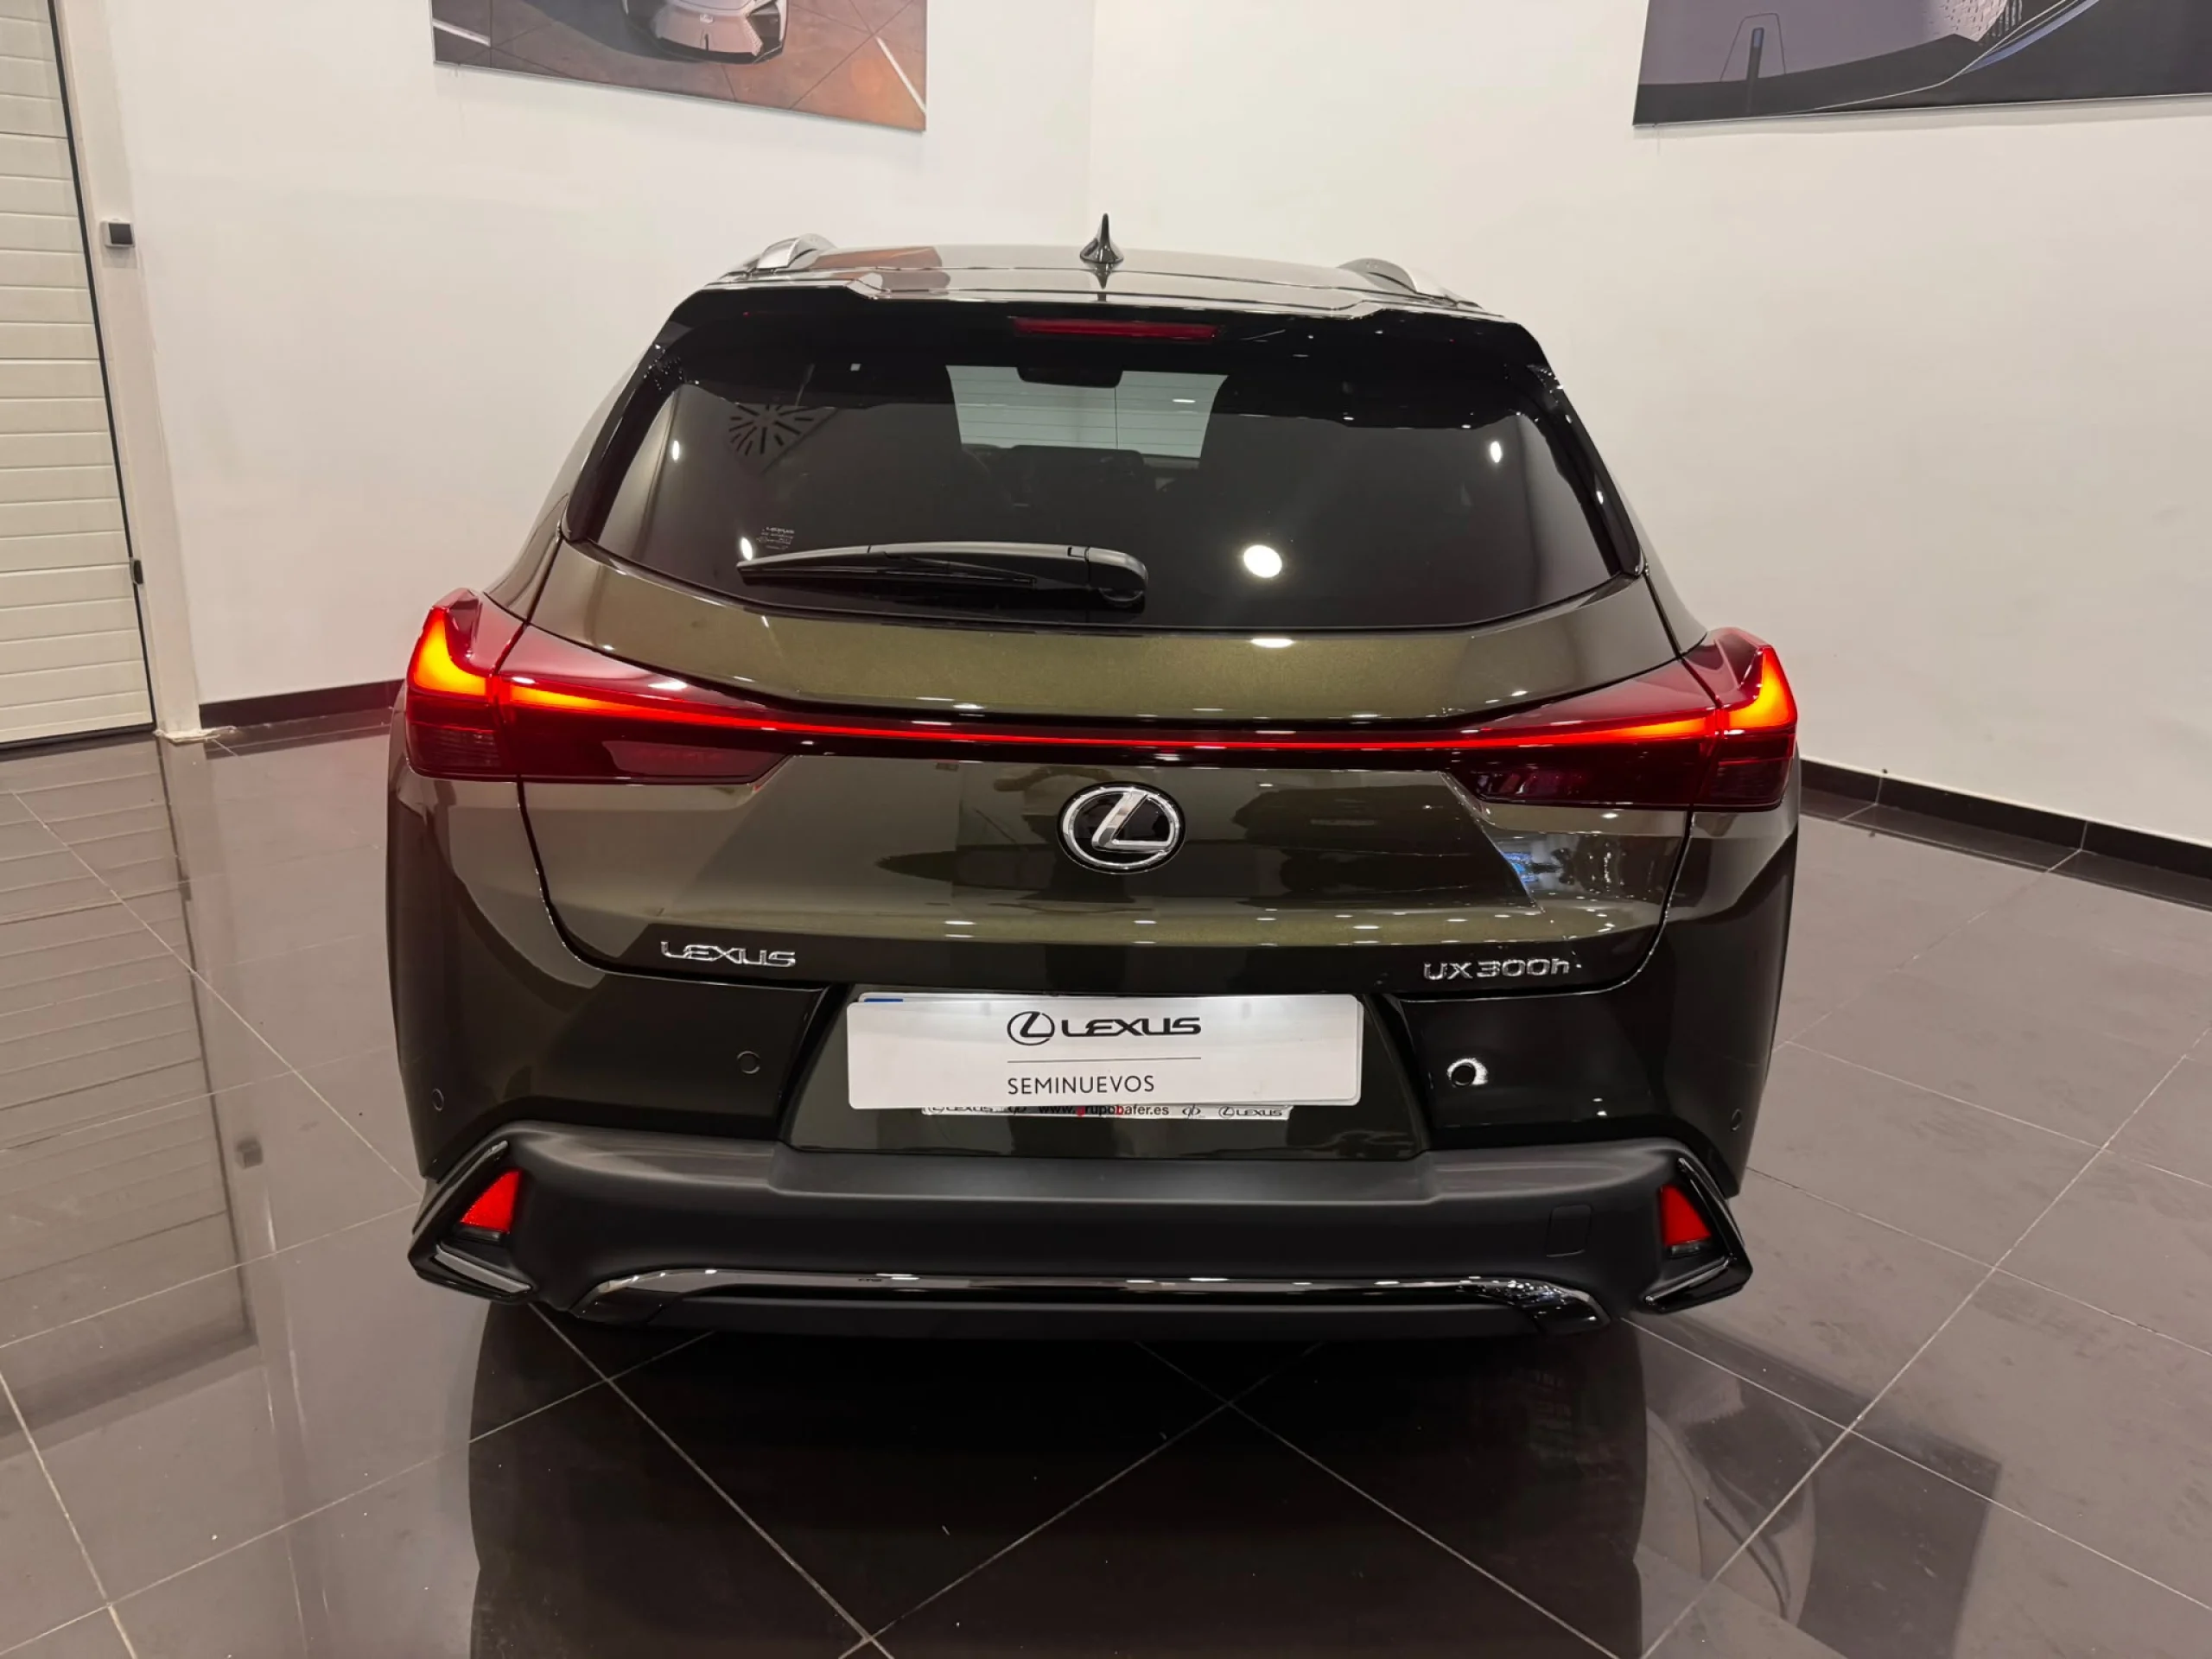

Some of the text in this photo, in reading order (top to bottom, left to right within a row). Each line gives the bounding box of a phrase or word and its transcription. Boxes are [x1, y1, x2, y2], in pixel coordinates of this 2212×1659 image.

[661, 941, 796, 968] LEXUS
[1061, 1017, 1202, 1037] LEXUS
[1007, 1075, 1154, 1095] SEMINUEVOS
